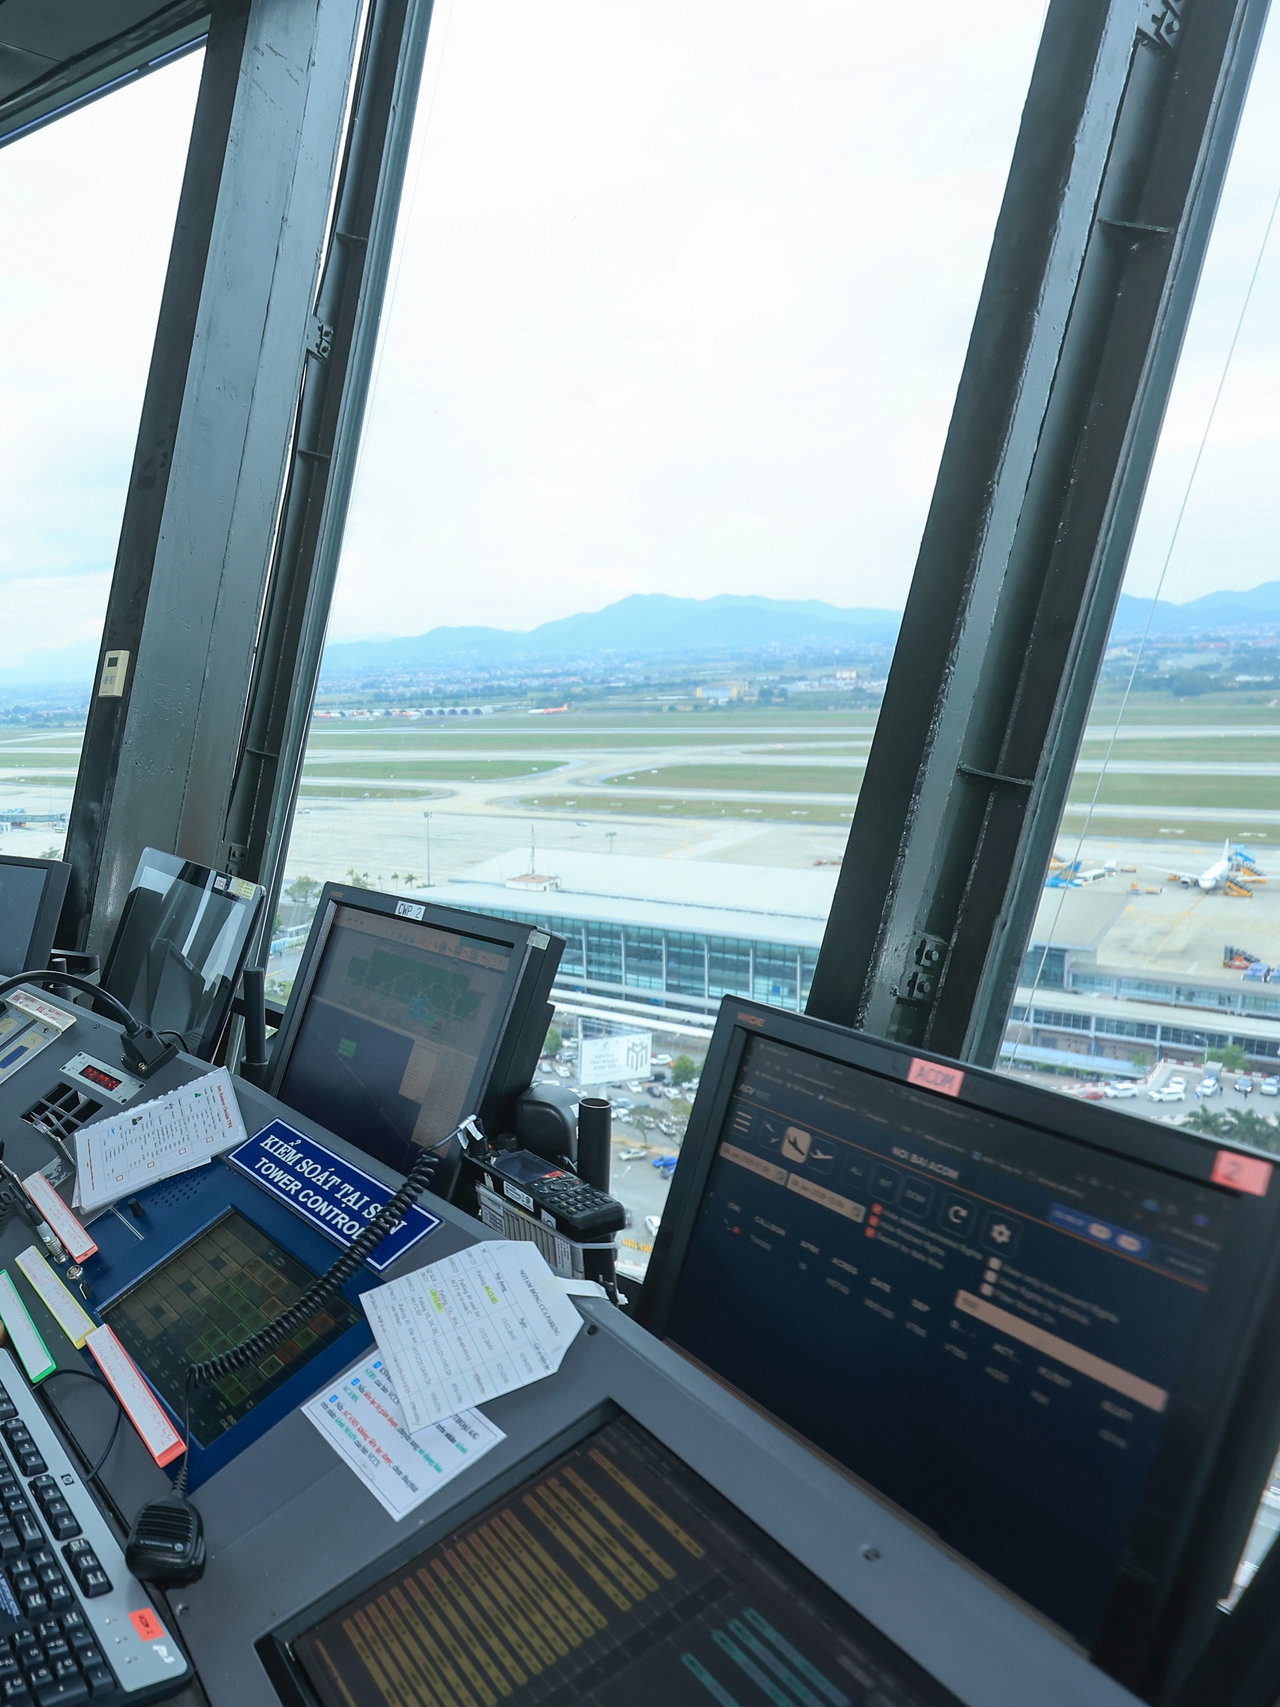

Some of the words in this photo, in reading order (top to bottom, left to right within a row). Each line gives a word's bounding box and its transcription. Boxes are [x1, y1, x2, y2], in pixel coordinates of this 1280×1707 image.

[397, 903, 412, 917] CWP
[415, 907, 421, 918] 2
[737, 1011, 766, 1028] WIDE
[915, 1064, 955, 1090] ACDM
[892, 1146, 909, 1160] NOI
[910, 1153, 928, 1167] BAI
[255, 1157, 302, 1195] TOWER
[1226, 1160, 1244, 1182] 2
[260, 1135, 303, 1166] KIỂM
[295, 1158, 342, 1191] SOÁT
[334, 1183, 370, 1211] TẠI
[362, 1203, 408, 1235] SN
[456, 1279, 469, 1294] Parking
[474, 1270, 487, 1286] Parking
[437, 1289, 448, 1305] Parking
